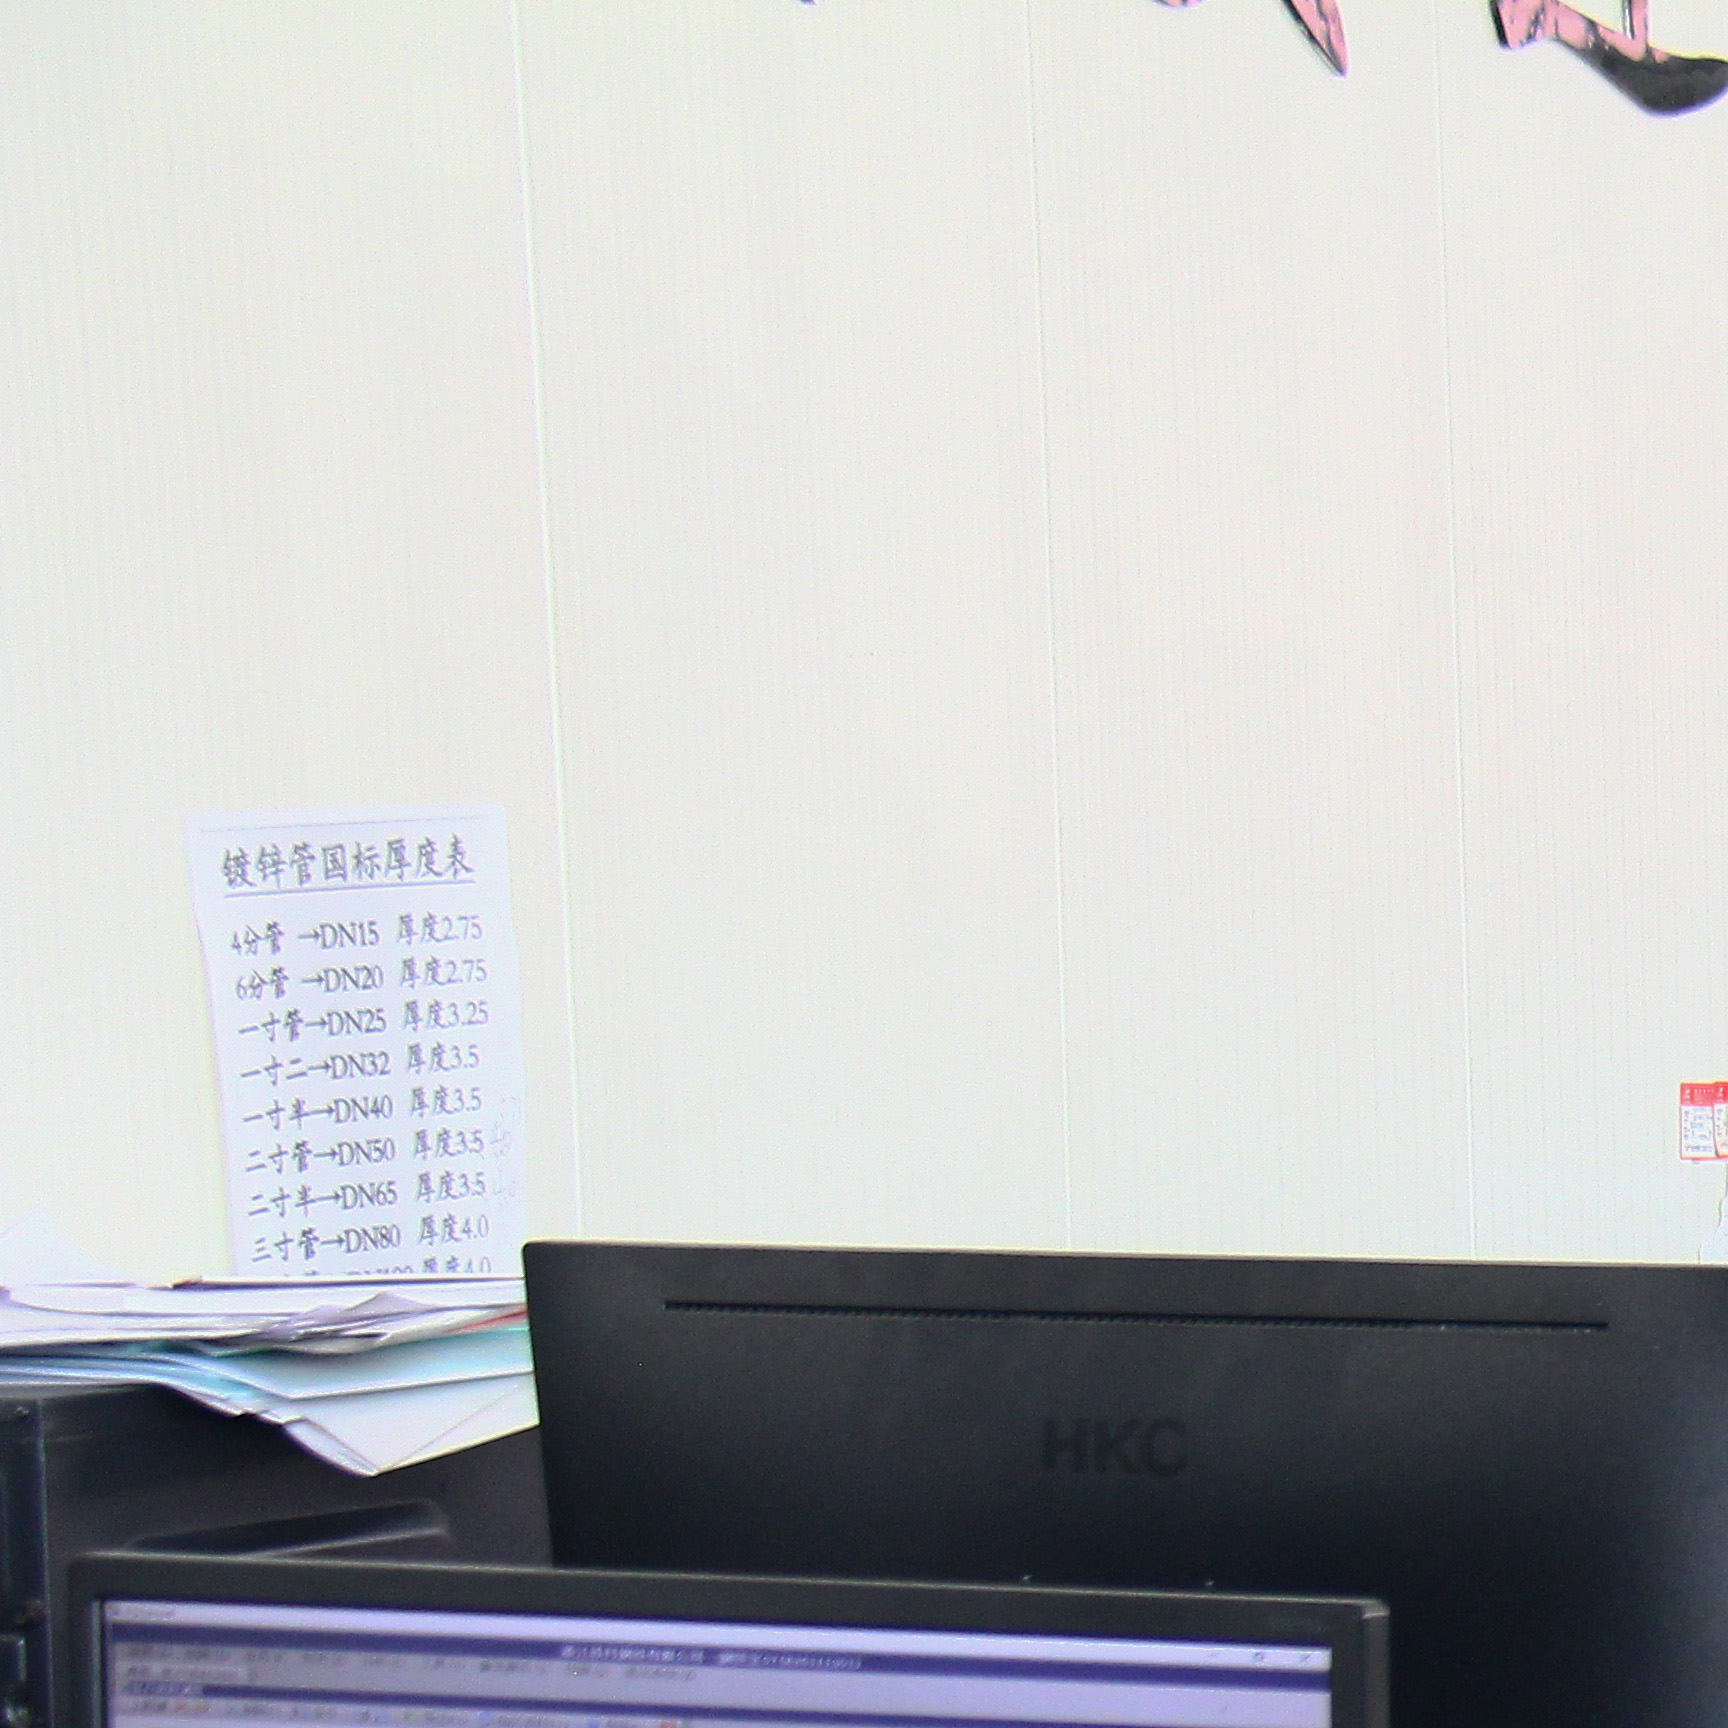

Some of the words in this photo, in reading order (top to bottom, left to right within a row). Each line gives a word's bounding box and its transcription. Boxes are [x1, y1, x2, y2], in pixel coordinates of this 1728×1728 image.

[222, 832, 475, 889] 镀锌管国标厚度表
[1042, 1418, 1186, 1476] HKC
